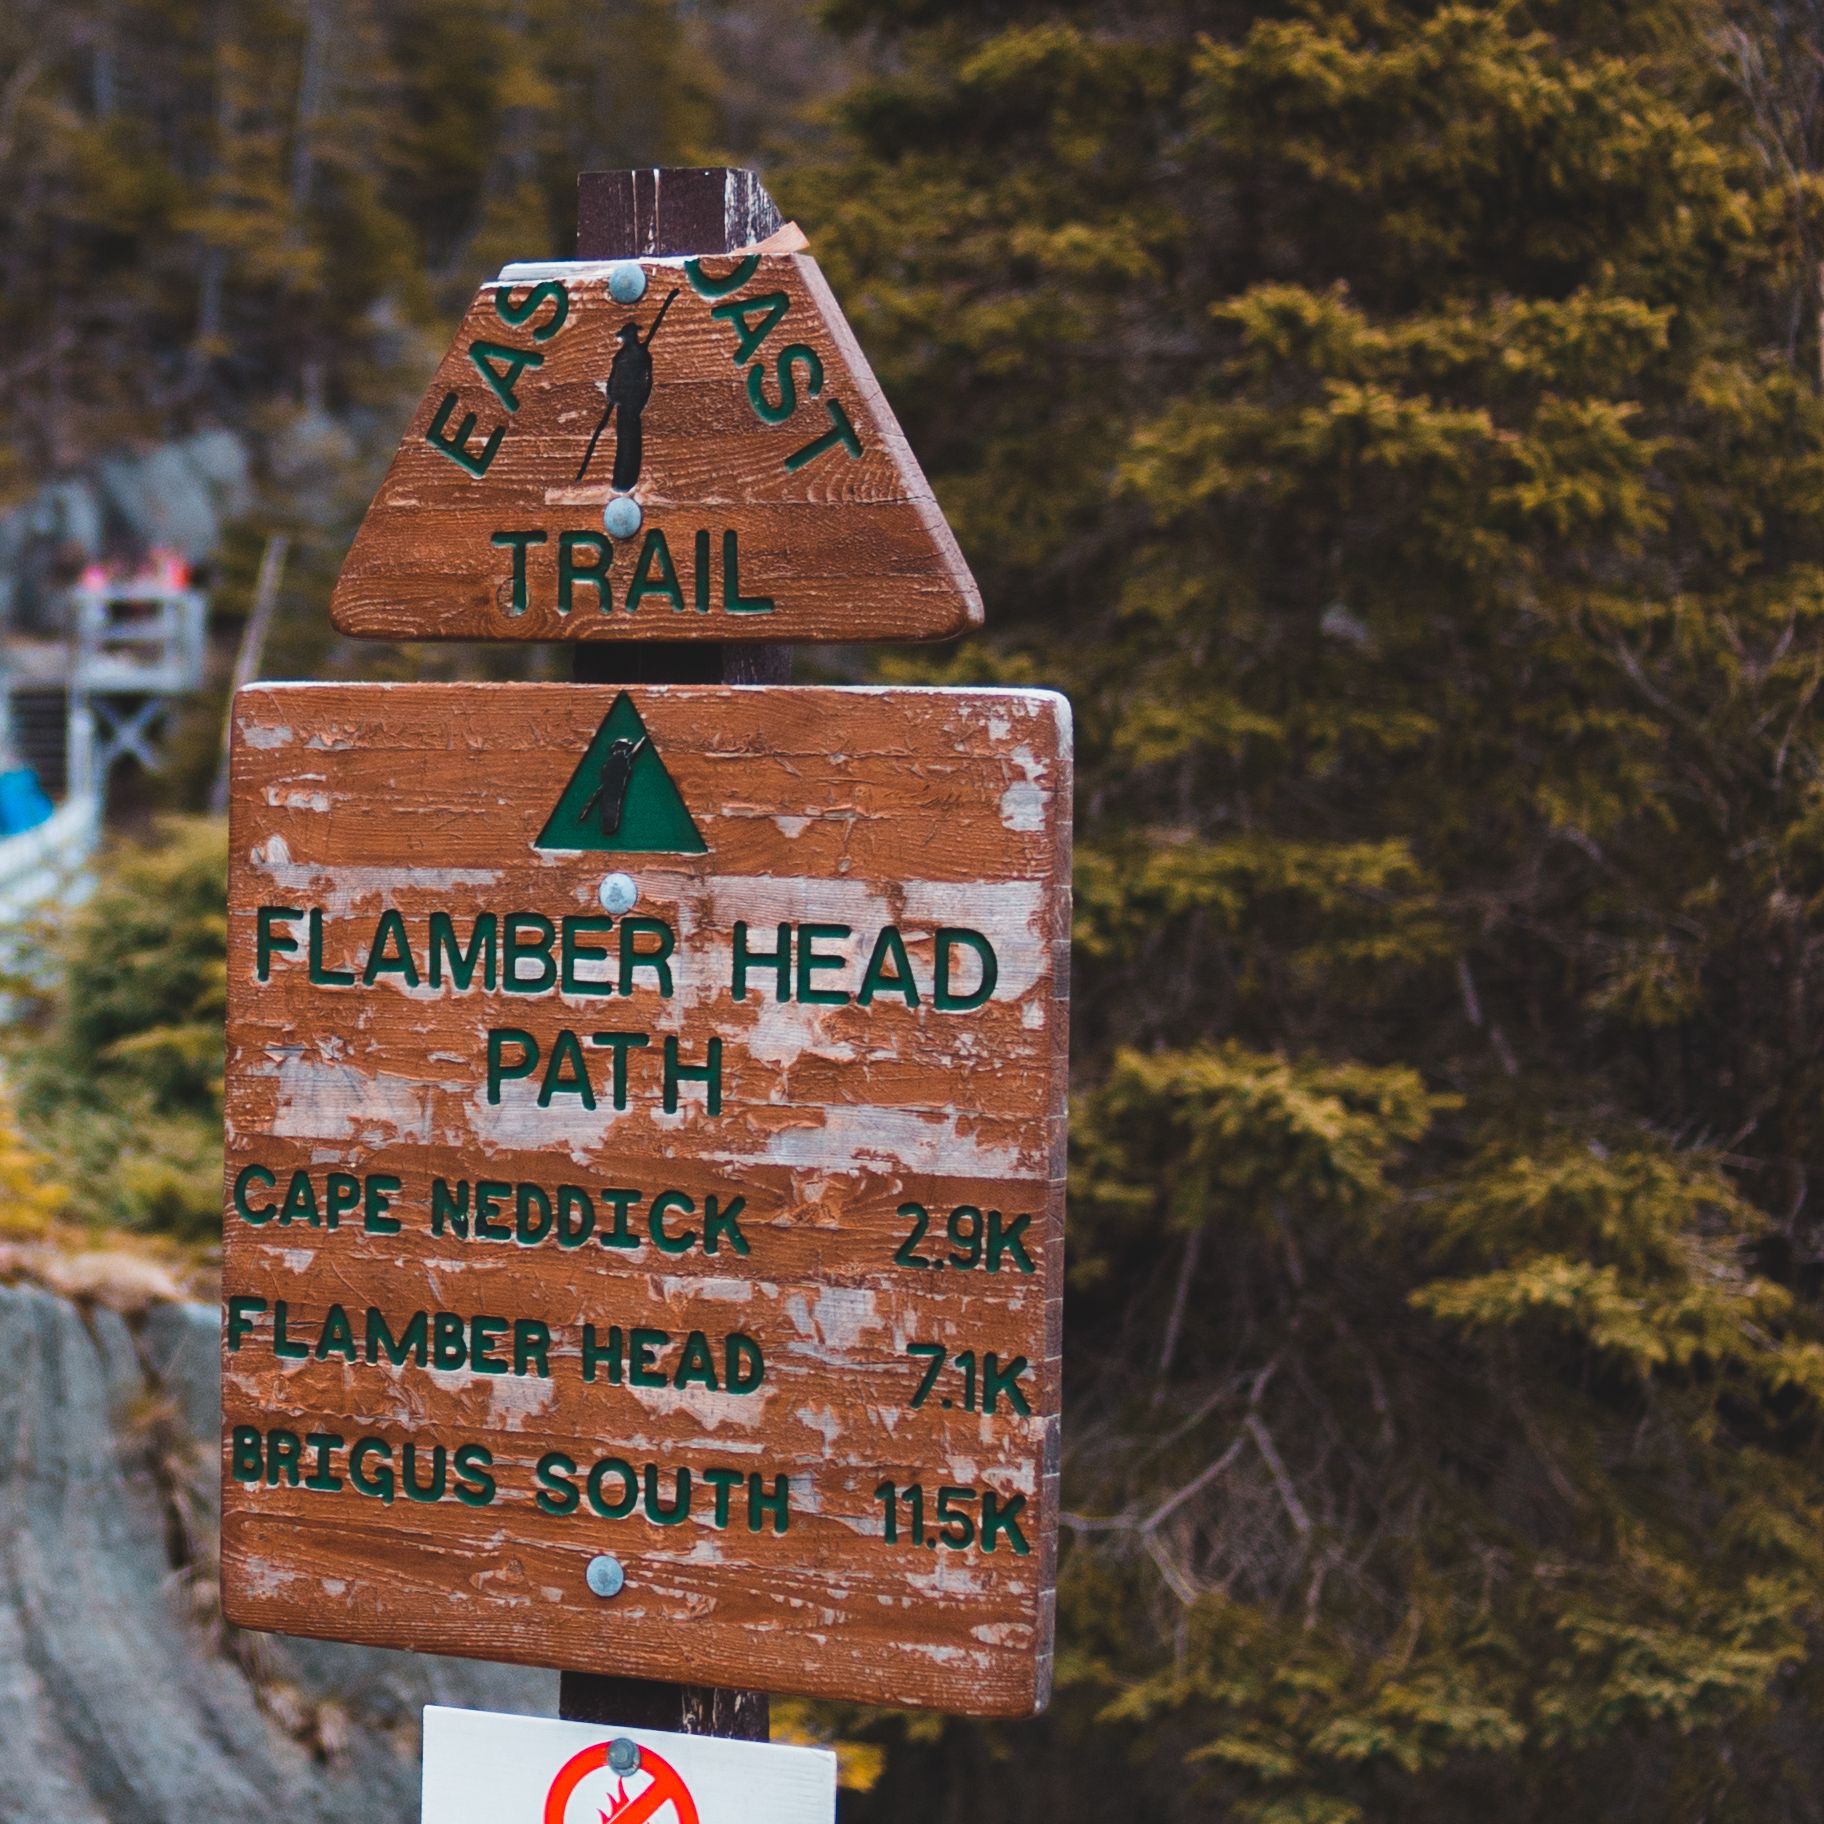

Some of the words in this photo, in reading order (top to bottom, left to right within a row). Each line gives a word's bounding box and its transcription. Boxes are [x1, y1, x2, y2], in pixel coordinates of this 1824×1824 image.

[489, 527, 774, 614] TRAIL
[255, 904, 675, 999] FLAMBER
[731, 919, 997, 1010] HEAD
[487, 1027, 723, 1116] PATH
[233, 1163, 402, 1235] CAPE
[432, 1177, 752, 1256] NEDDICK
[894, 1200, 1037, 1274] 2.9K
[227, 1295, 550, 1378] FLAMBER
[582, 1320, 766, 1396] HEAD
[905, 1341, 1033, 1417] 7.1K
[231, 1424, 497, 1508] BRIGUS
[535, 1450, 789, 1533] SOUTH
[875, 1480, 1031, 1556] 11.5K
